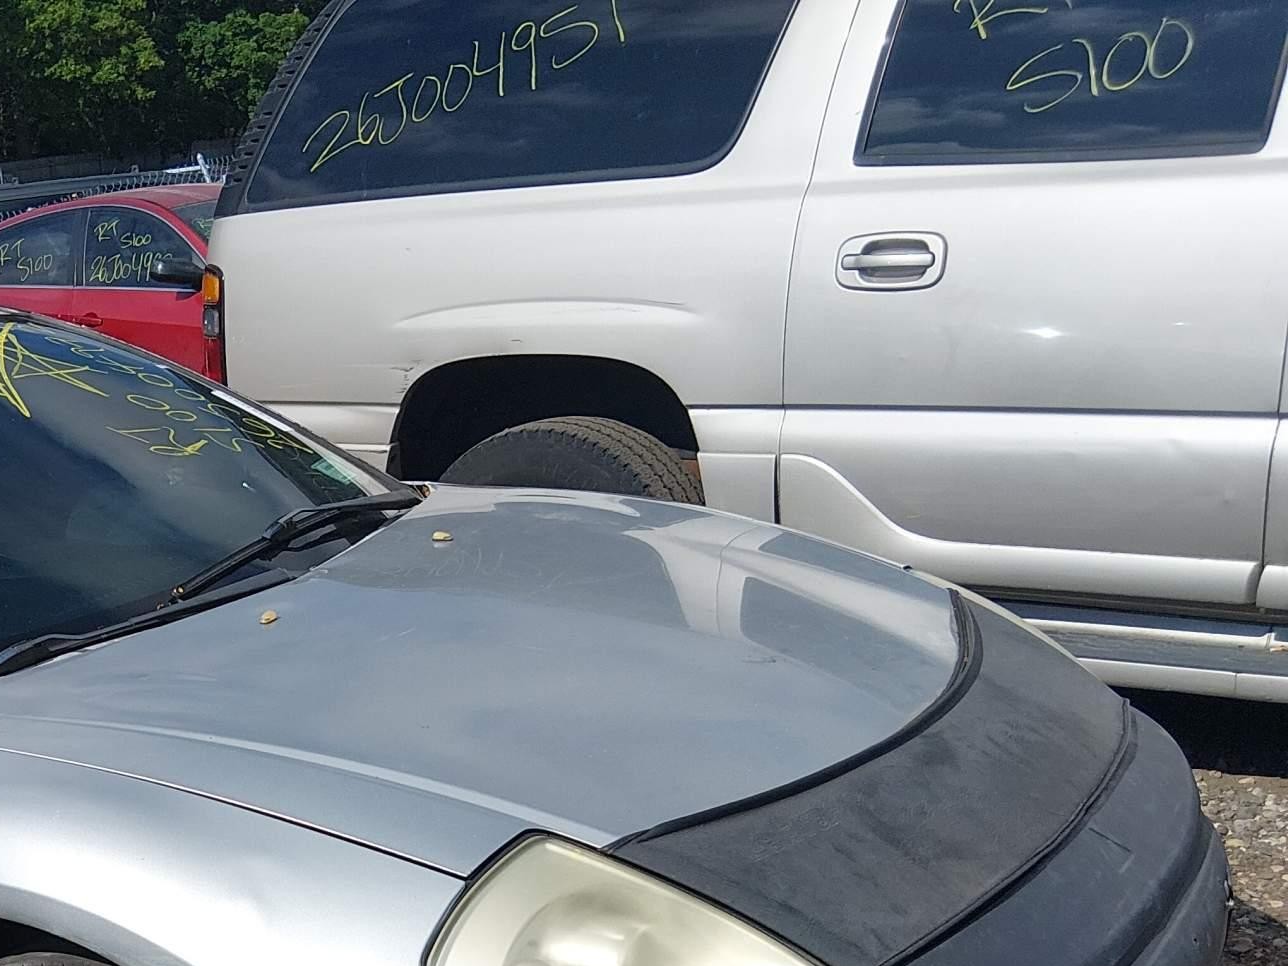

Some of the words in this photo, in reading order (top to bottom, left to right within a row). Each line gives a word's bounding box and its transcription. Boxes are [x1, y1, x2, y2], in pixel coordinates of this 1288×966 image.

[953, 0, 1074, 39] R
[1005, 17, 1194, 113] S100
[302, 0, 627, 173] 26J004951
[93, 217, 121, 243] RT
[120, 233, 152, 249] S100
[16, 254, 54, 282] S100
[89, 251, 174, 284] 26J0049
[126, 394, 265, 453] S100
[105, 426, 209, 457] RT
